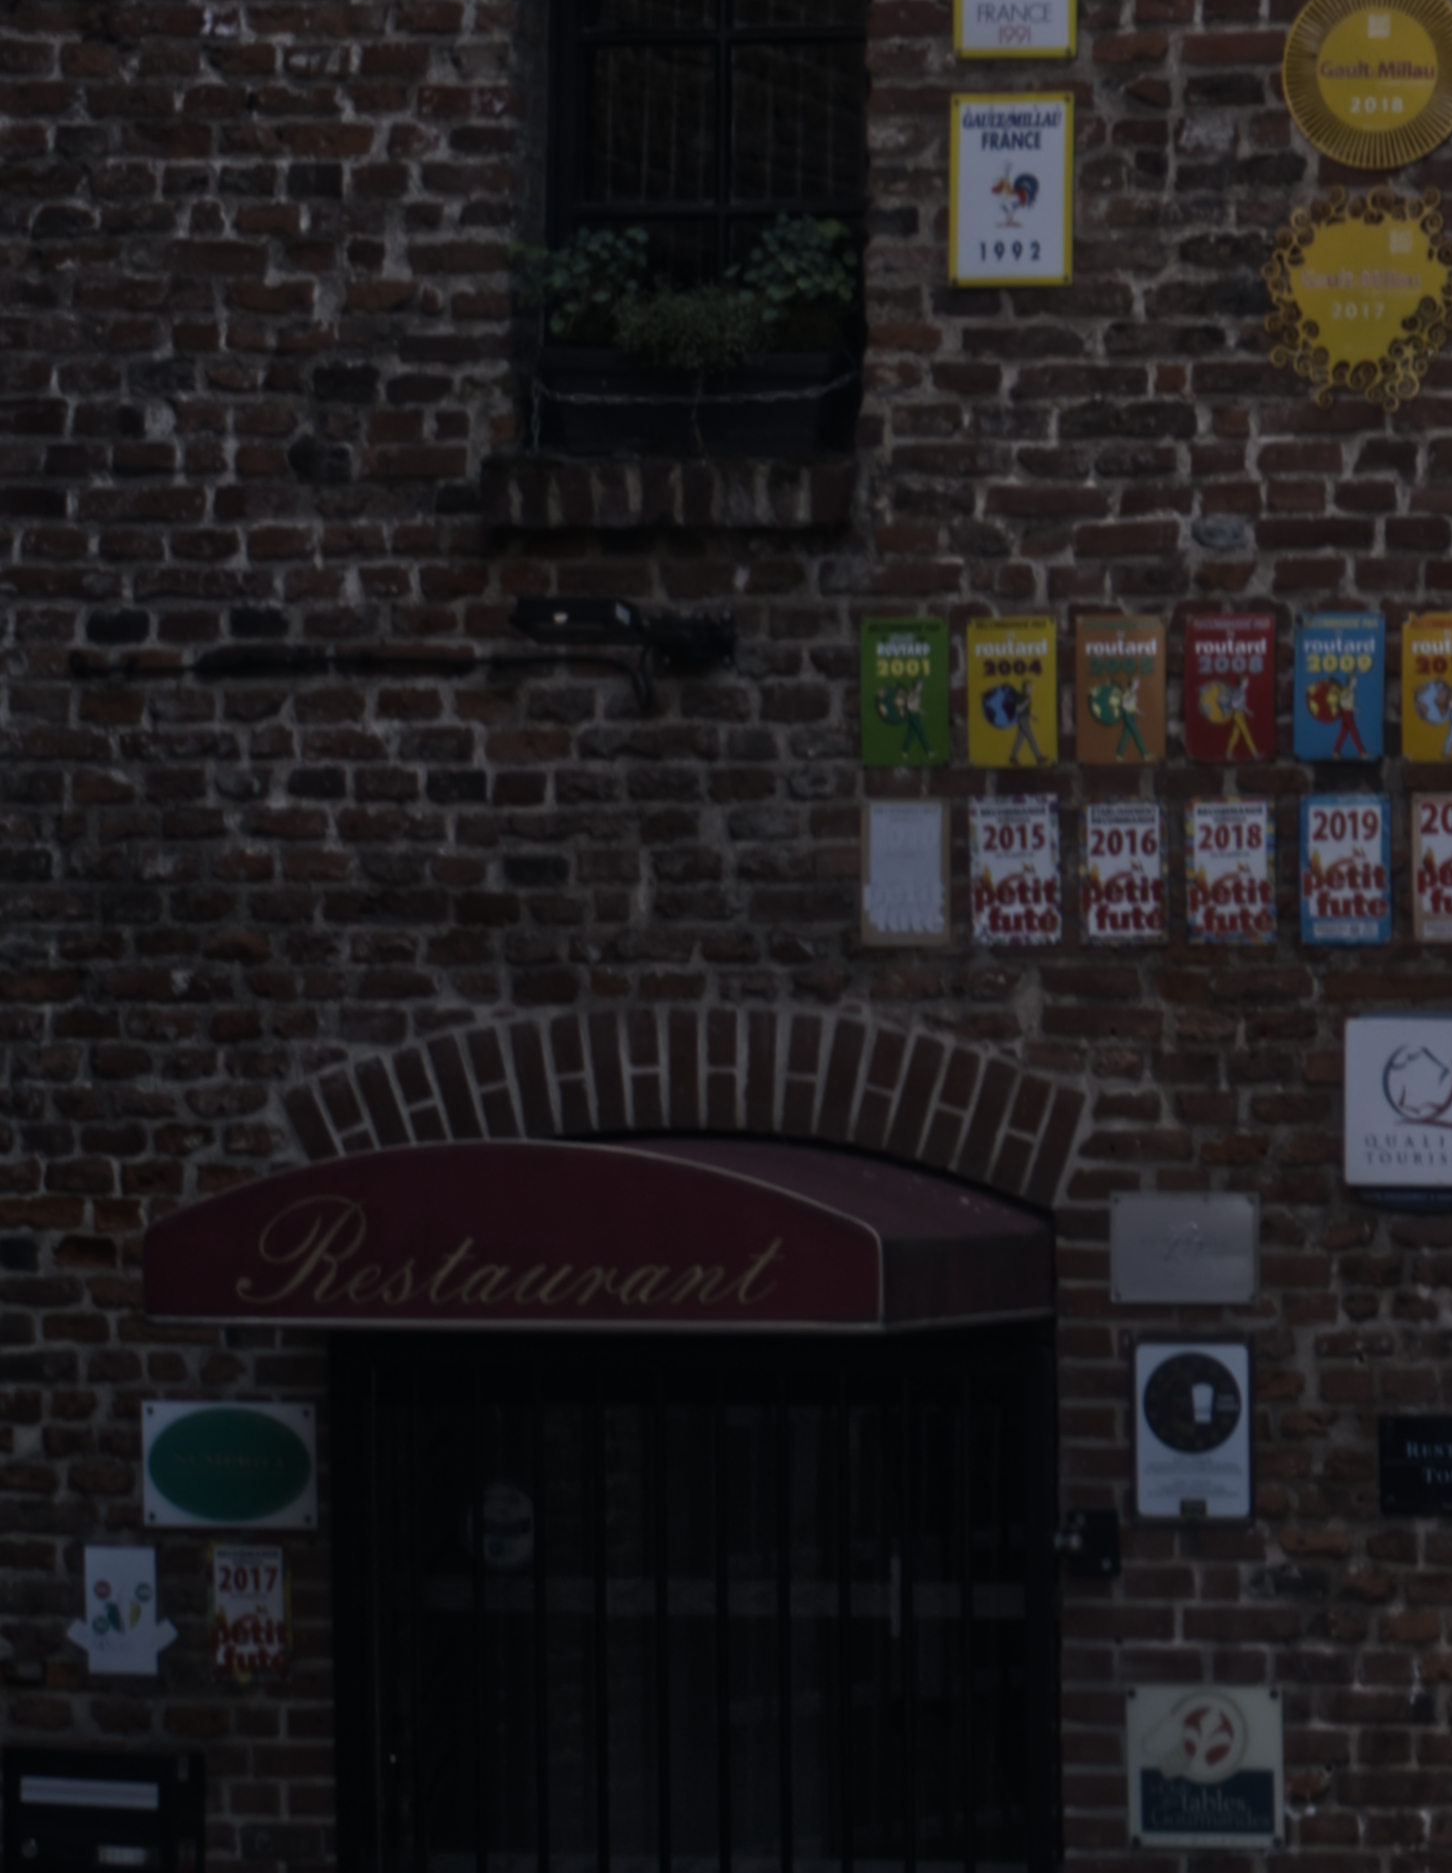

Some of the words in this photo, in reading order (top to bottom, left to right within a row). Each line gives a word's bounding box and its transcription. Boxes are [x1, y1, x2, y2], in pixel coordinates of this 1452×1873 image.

[976, 2, 1053, 24] FRANCE
[998, 24, 1033, 45] 1991
[1349, 95, 1405, 113] 2018
[981, 130, 1043, 150] FRANCE
[979, 240, 1041, 262] 1992
[1330, 299, 1385, 321] 2017
[974, 636, 1049, 657] routard
[1084, 636, 1158, 657] routard
[1193, 636, 1268, 656] routard
[1302, 635, 1376, 655] routard
[876, 659, 931, 677] 2001
[983, 660, 1042, 677] 2004
[1305, 653, 1373, 674] 2009
[1312, 809, 1379, 841] 2019
[983, 823, 1046, 851] 2015
[1089, 828, 1158, 857] 2016
[1197, 822, 1263, 851] 2018
[1302, 861, 1387, 897] petit
[974, 876, 1058, 914] petit
[1081, 875, 1165, 913] petit
[1189, 876, 1272, 913] petit
[235, 1192, 790, 1306] Restaurant
[218, 1564, 280, 1593] 2017
